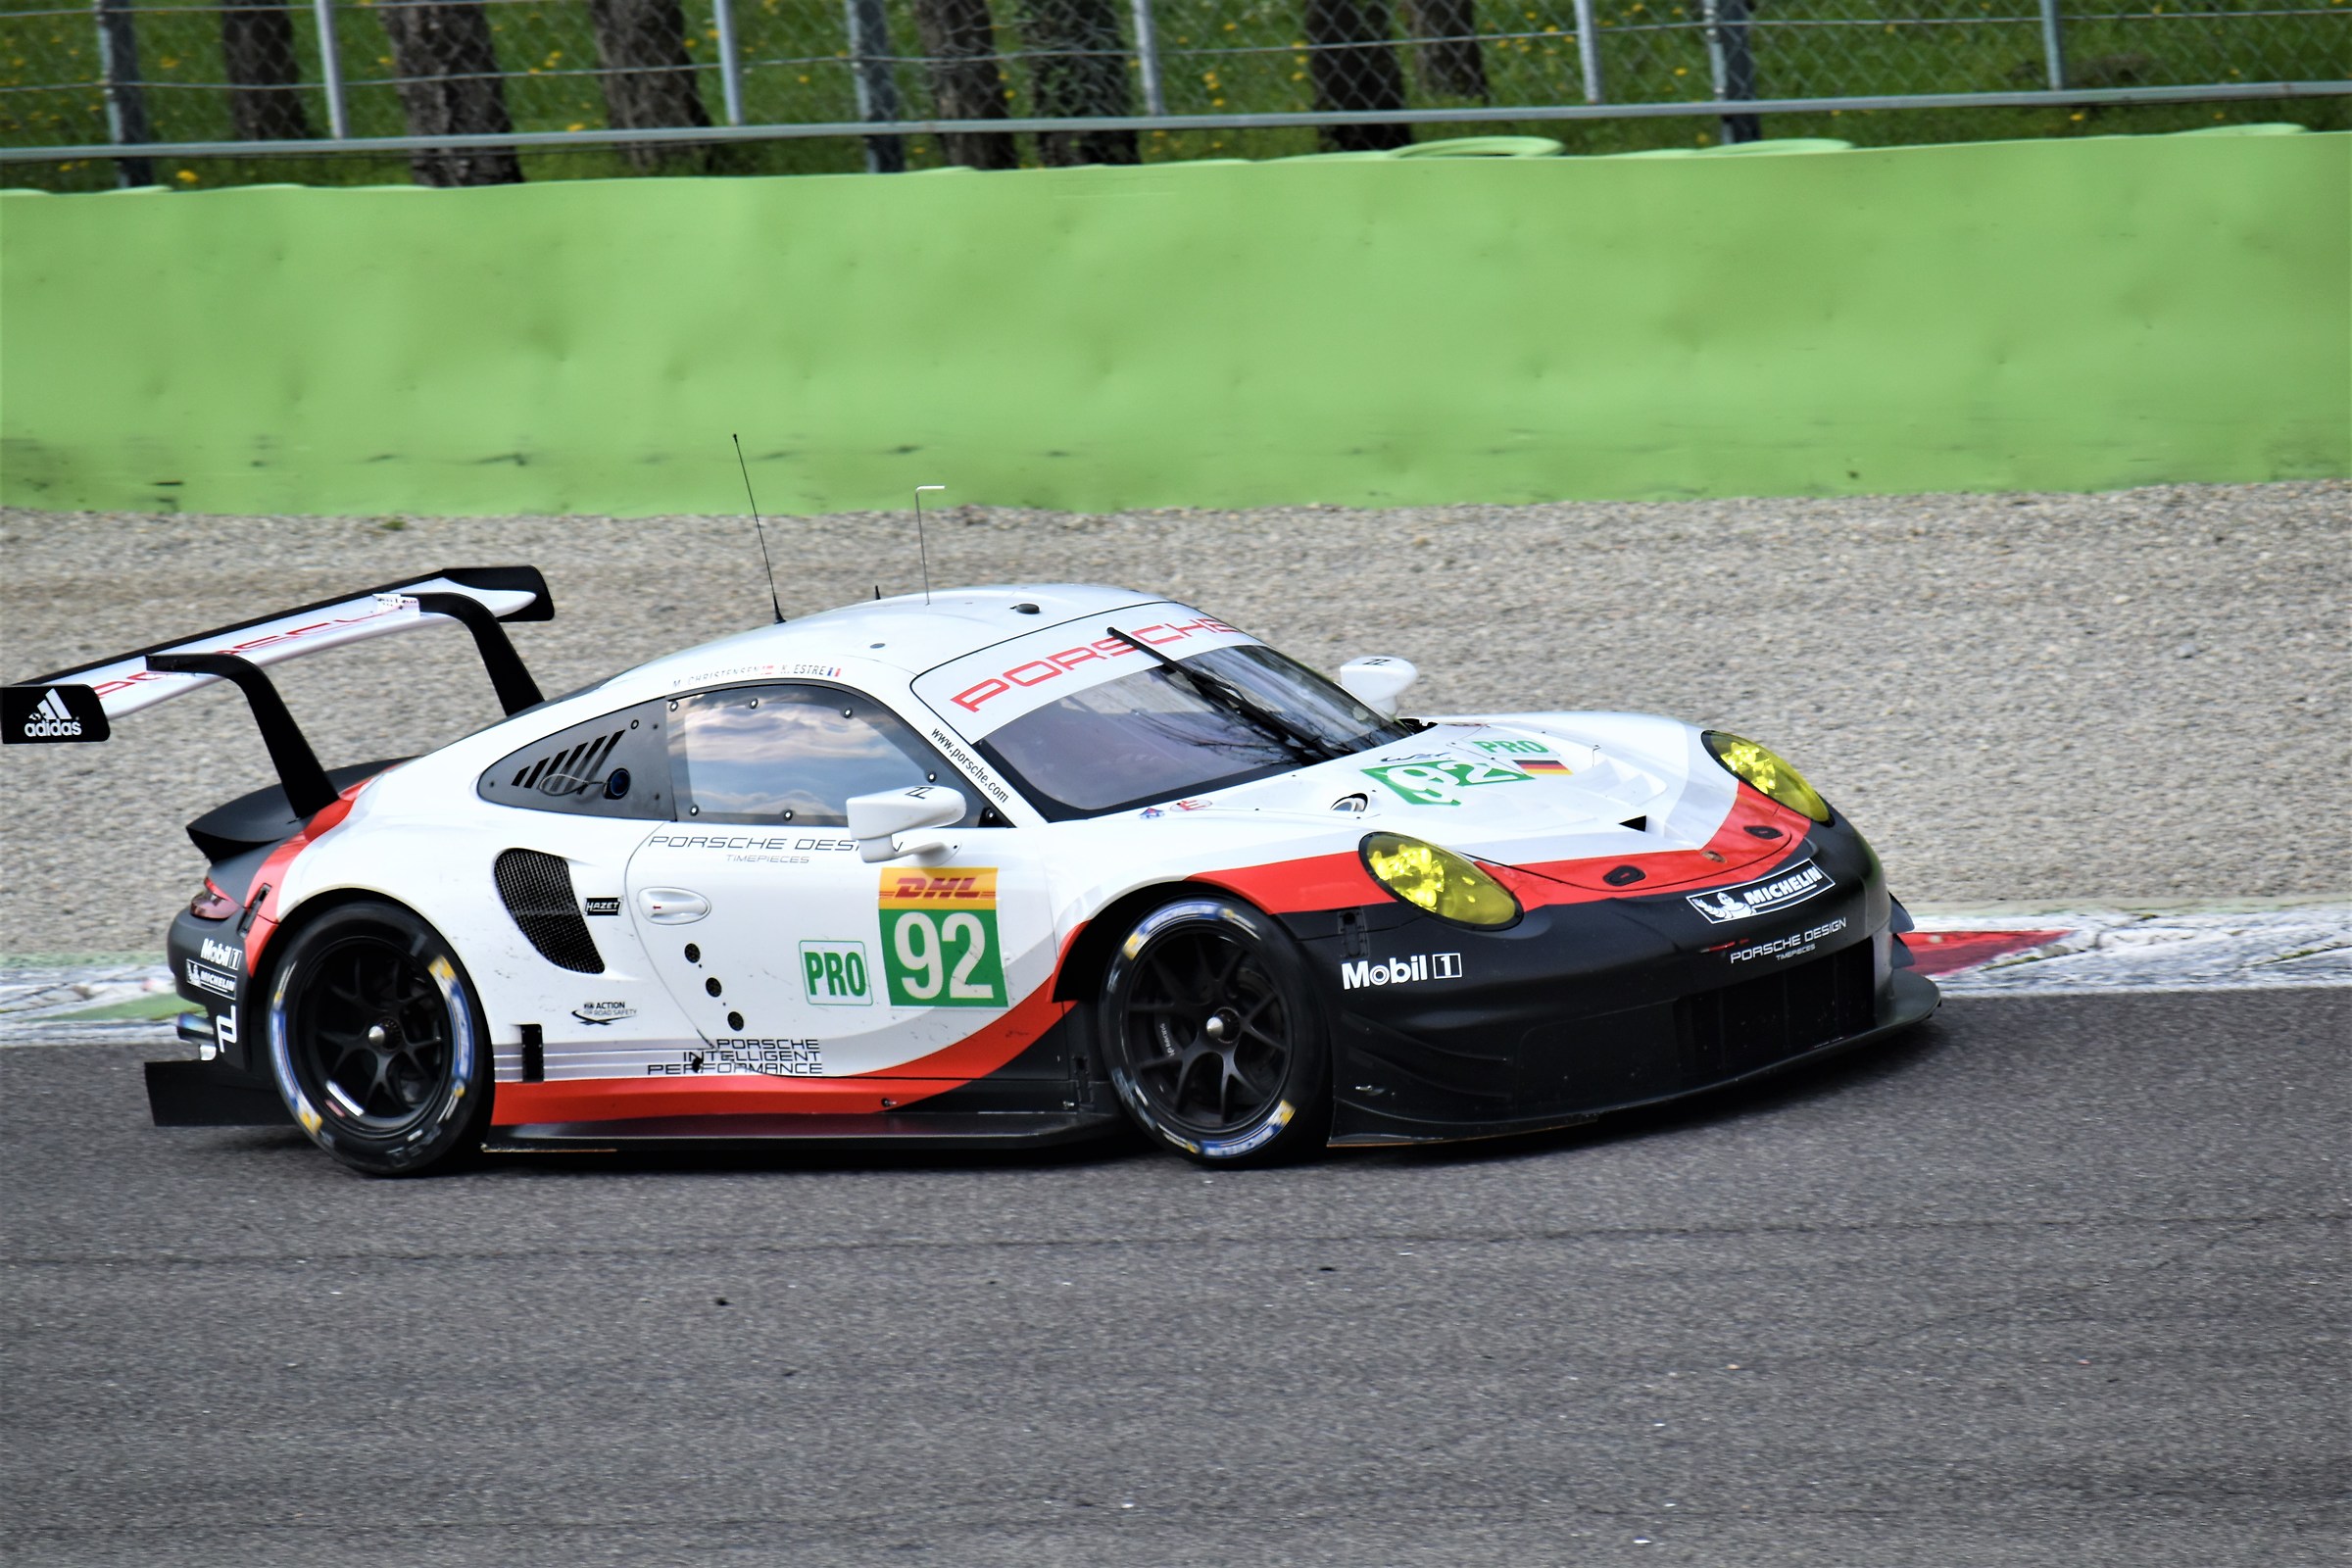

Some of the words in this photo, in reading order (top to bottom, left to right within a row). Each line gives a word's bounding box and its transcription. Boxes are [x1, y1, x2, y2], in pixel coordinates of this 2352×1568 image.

[793, 663, 827, 676] ESTRE
[950, 617, 1239, 712] PORSCHE
[24, 718, 82, 737] adidas
[1472, 740, 1549, 754] PRO
[931, 727, 1009, 804] www.porsche.com
[1385, 759, 1519, 804] 92
[648, 836, 787, 850] PORSCHE
[725, 854, 810, 864] TIMEPIECES
[894, 877, 981, 899] DHL
[1743, 866, 1823, 906] MICHELIN
[586, 901, 619, 911] HAZET
[1730, 934, 1802, 964] PORSCHE
[1804, 917, 1847, 943] DESIGN
[200, 938, 231, 967] Mobil
[894, 911, 994, 1000] 92
[1776, 944, 1816, 961] TIMEPIECES
[200, 970, 235, 992] MICHELIN
[804, 952, 866, 997] PRO
[1342, 955, 1428, 990] Mobil
[716, 1039, 819, 1050] PORSCHE
[683, 1051, 821, 1061] INTELLIGENT
[648, 1062, 822, 1075] PERFORMANCE
